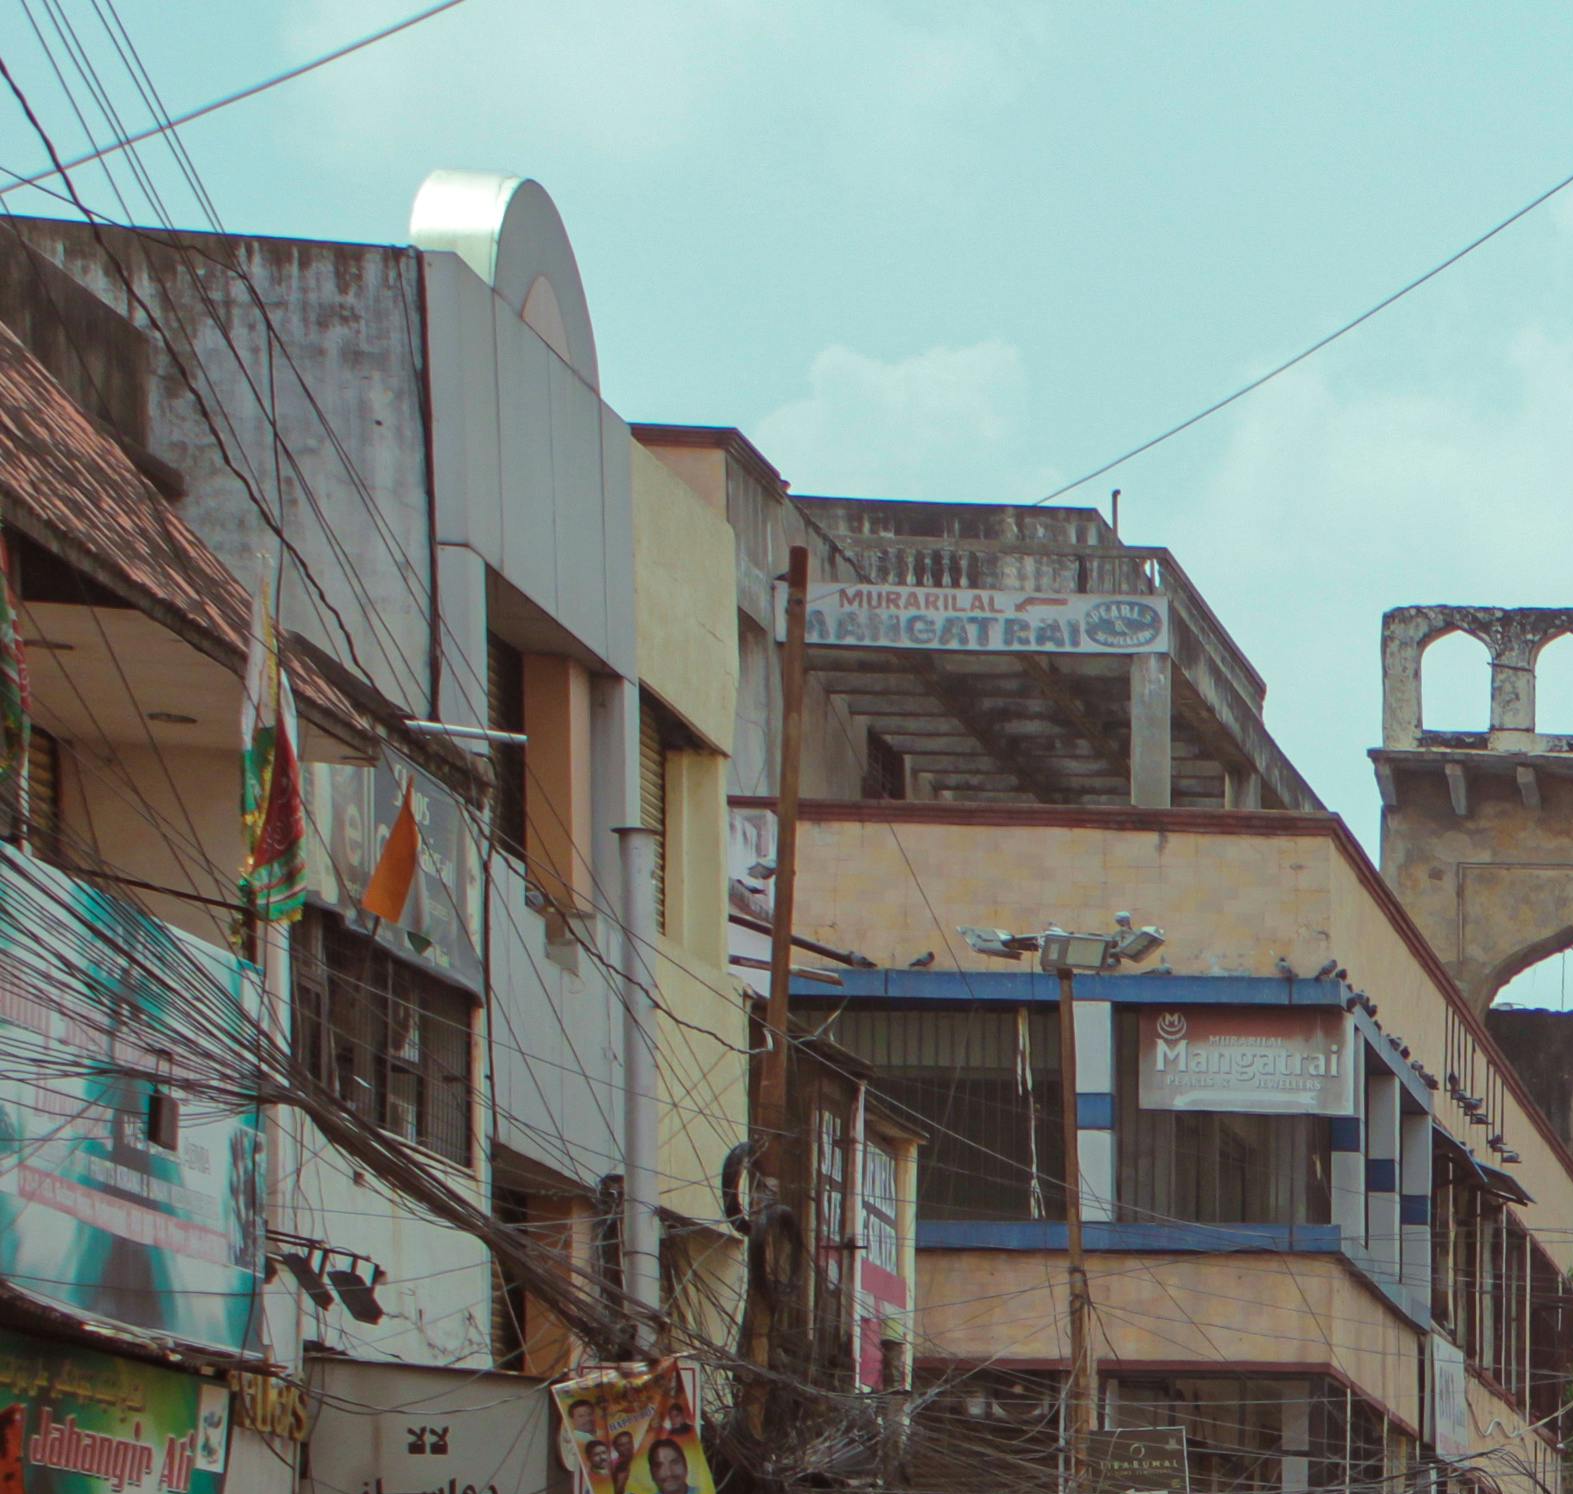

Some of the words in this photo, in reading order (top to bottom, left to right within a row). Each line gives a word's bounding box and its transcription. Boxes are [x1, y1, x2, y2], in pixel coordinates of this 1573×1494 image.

[838, 588, 1006, 614] MURARILAL
[1155, 1038, 1341, 1081] Mangatrai
[29, 1406, 153, 1493] Jahangir
